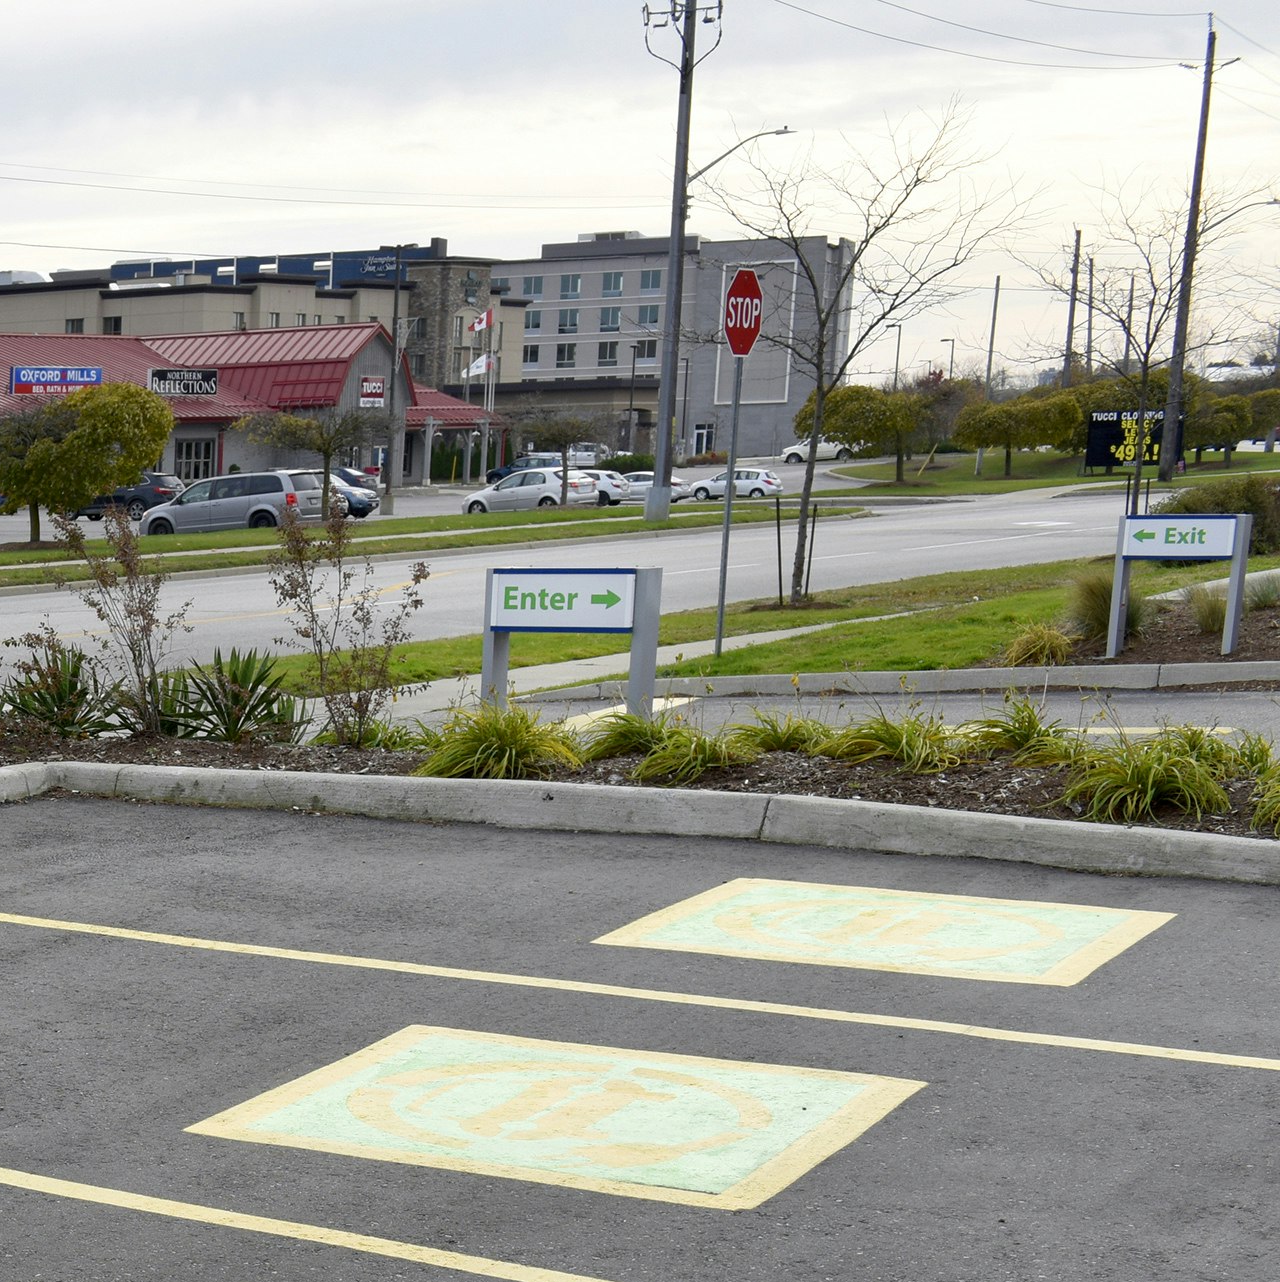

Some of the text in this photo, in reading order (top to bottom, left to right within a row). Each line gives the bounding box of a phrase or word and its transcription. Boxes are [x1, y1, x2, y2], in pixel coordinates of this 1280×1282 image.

[727, 296, 760, 329] STOP
[20, 369, 97, 382] OXFORD MILLS
[166, 371, 202, 380] NORTHERN
[152, 377, 216, 394] REFLECTIONS
[363, 382, 383, 393] TUCCI
[1091, 412, 1118, 421] TUCCI
[1164, 527, 1207, 545] Exit
[503, 586, 579, 611] Enter
